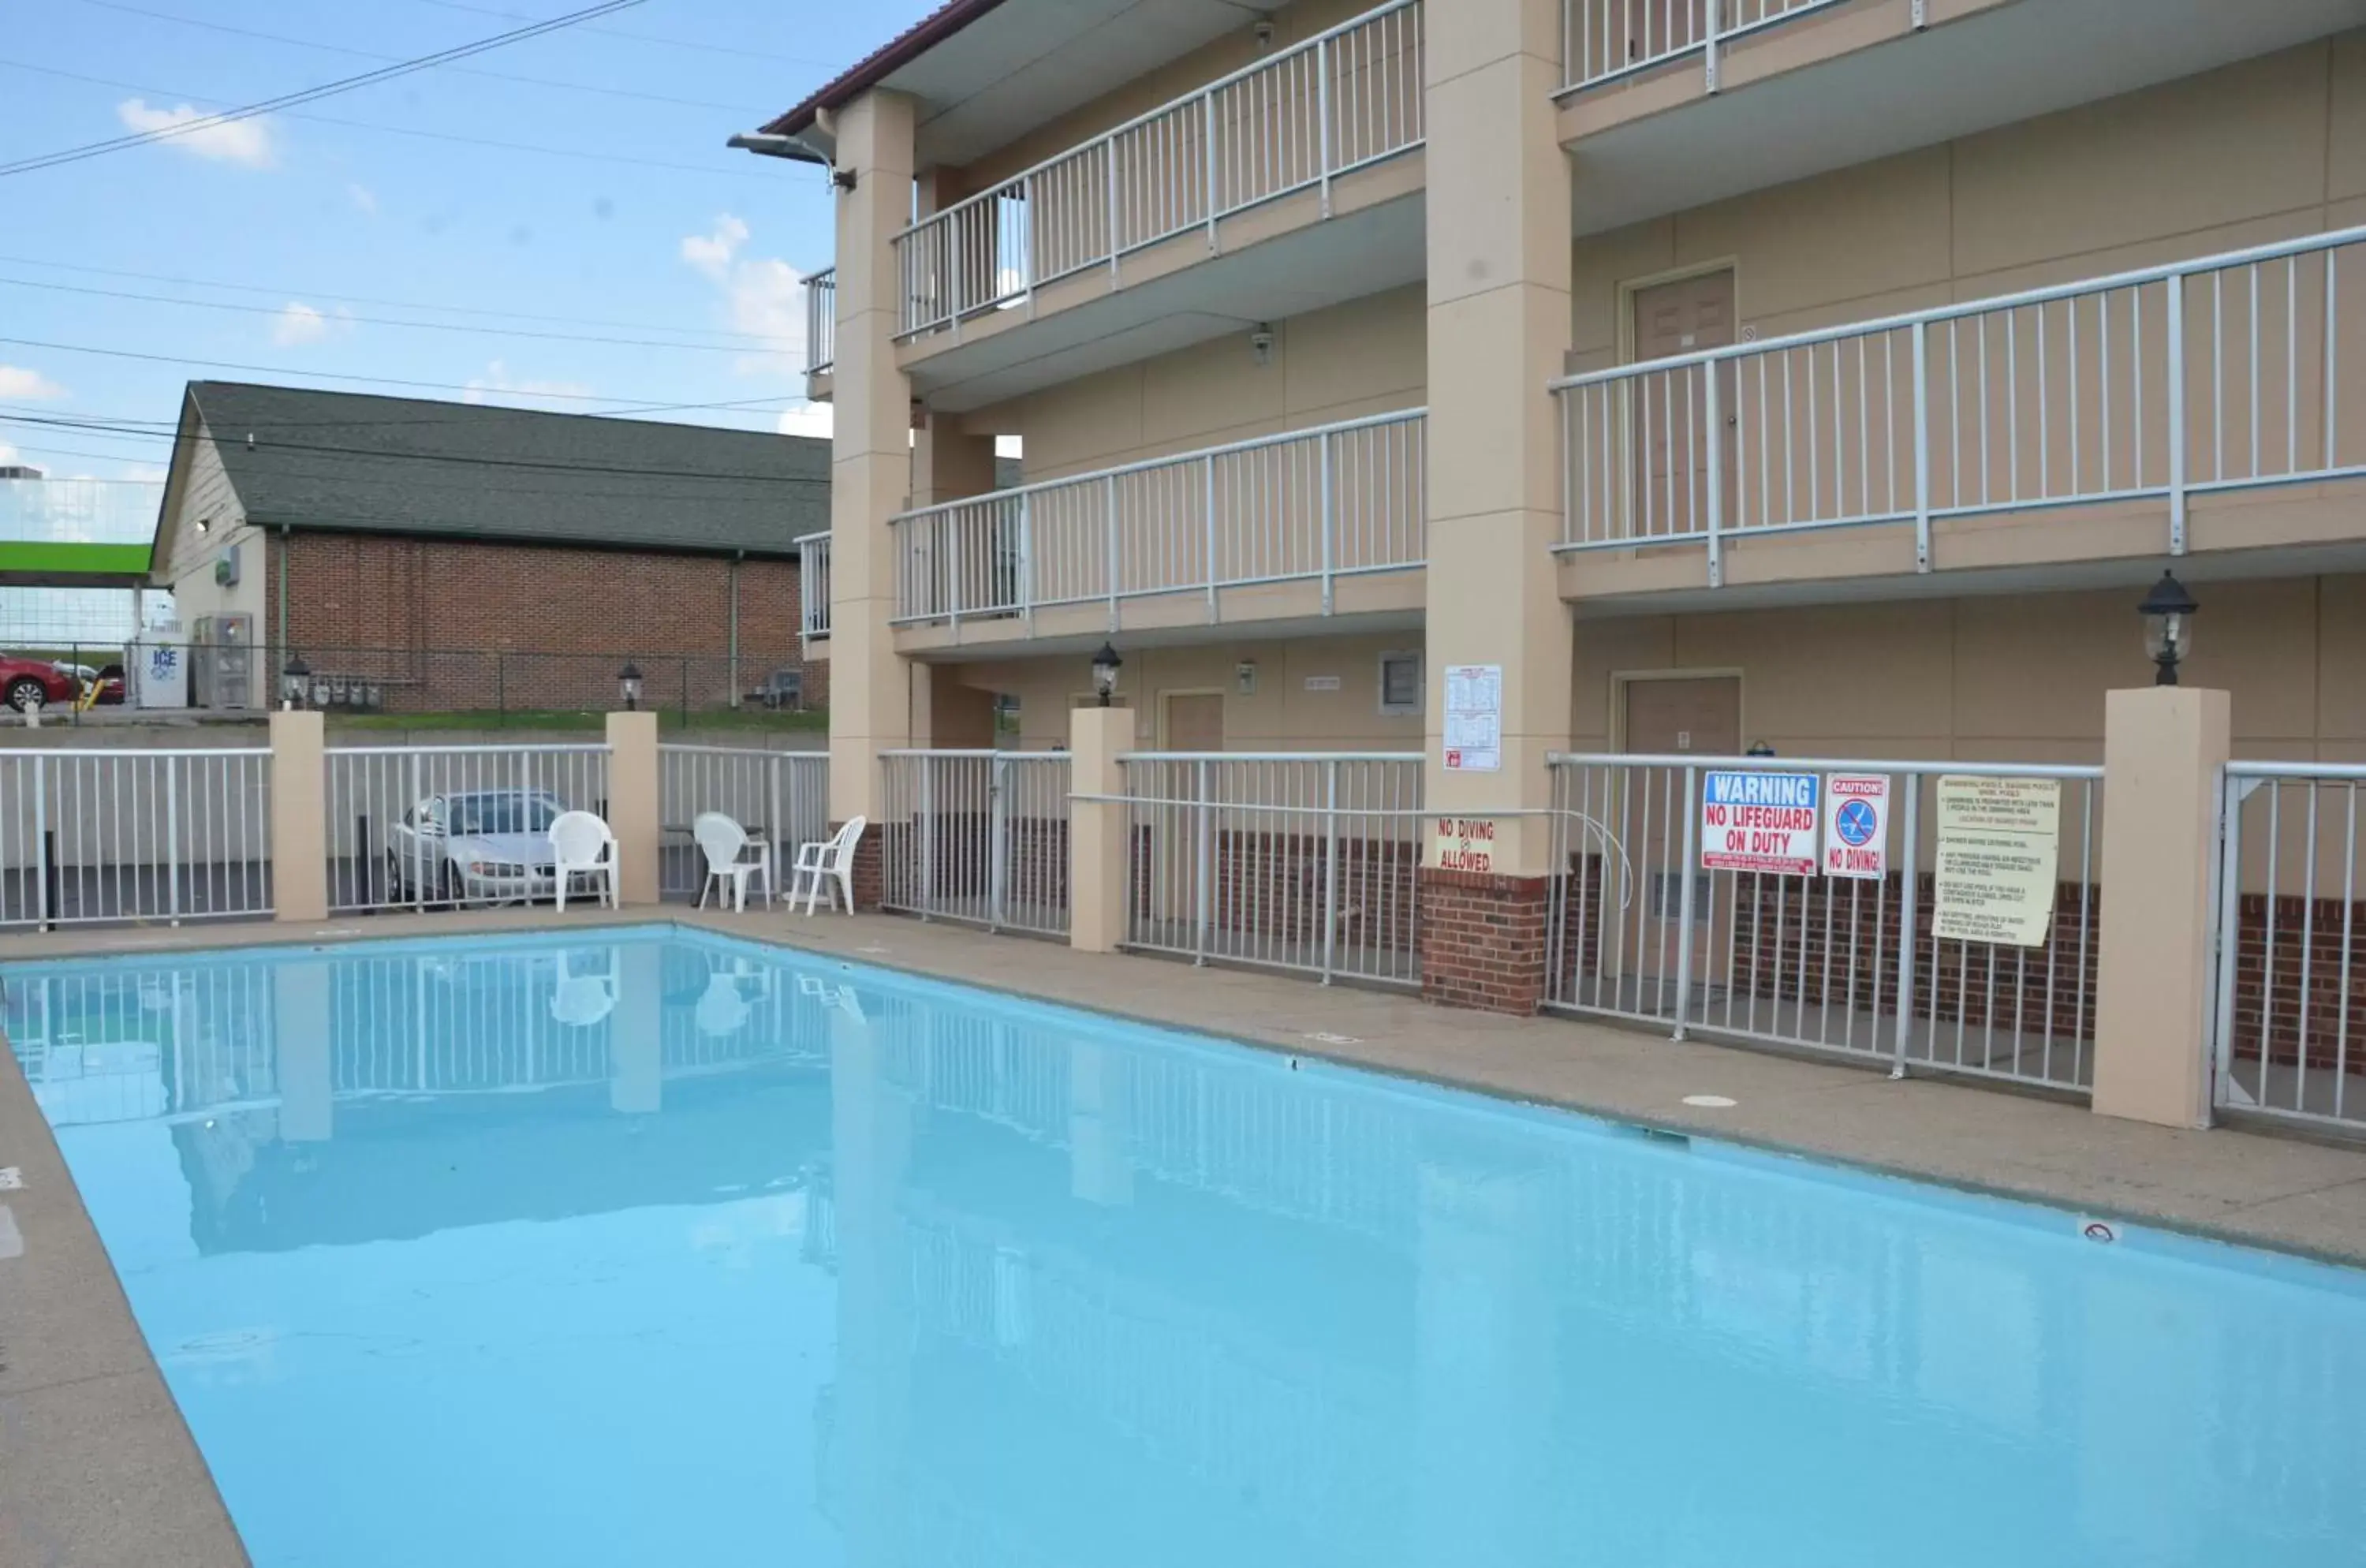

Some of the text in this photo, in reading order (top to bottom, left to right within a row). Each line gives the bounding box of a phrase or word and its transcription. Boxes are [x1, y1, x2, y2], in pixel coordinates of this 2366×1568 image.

[154, 650, 177, 666] ICE
[1715, 775, 1810, 805] WARNING
[1439, 818, 1493, 840] NO DIVING
[1707, 805, 1812, 831] NO LIFEGUARD
[1726, 830, 1790, 854] ON DUTY
[1441, 850, 1489, 872] ALLOWED
[1830, 848, 1842, 868] NO
[1846, 849, 1879, 872] DIVING!
